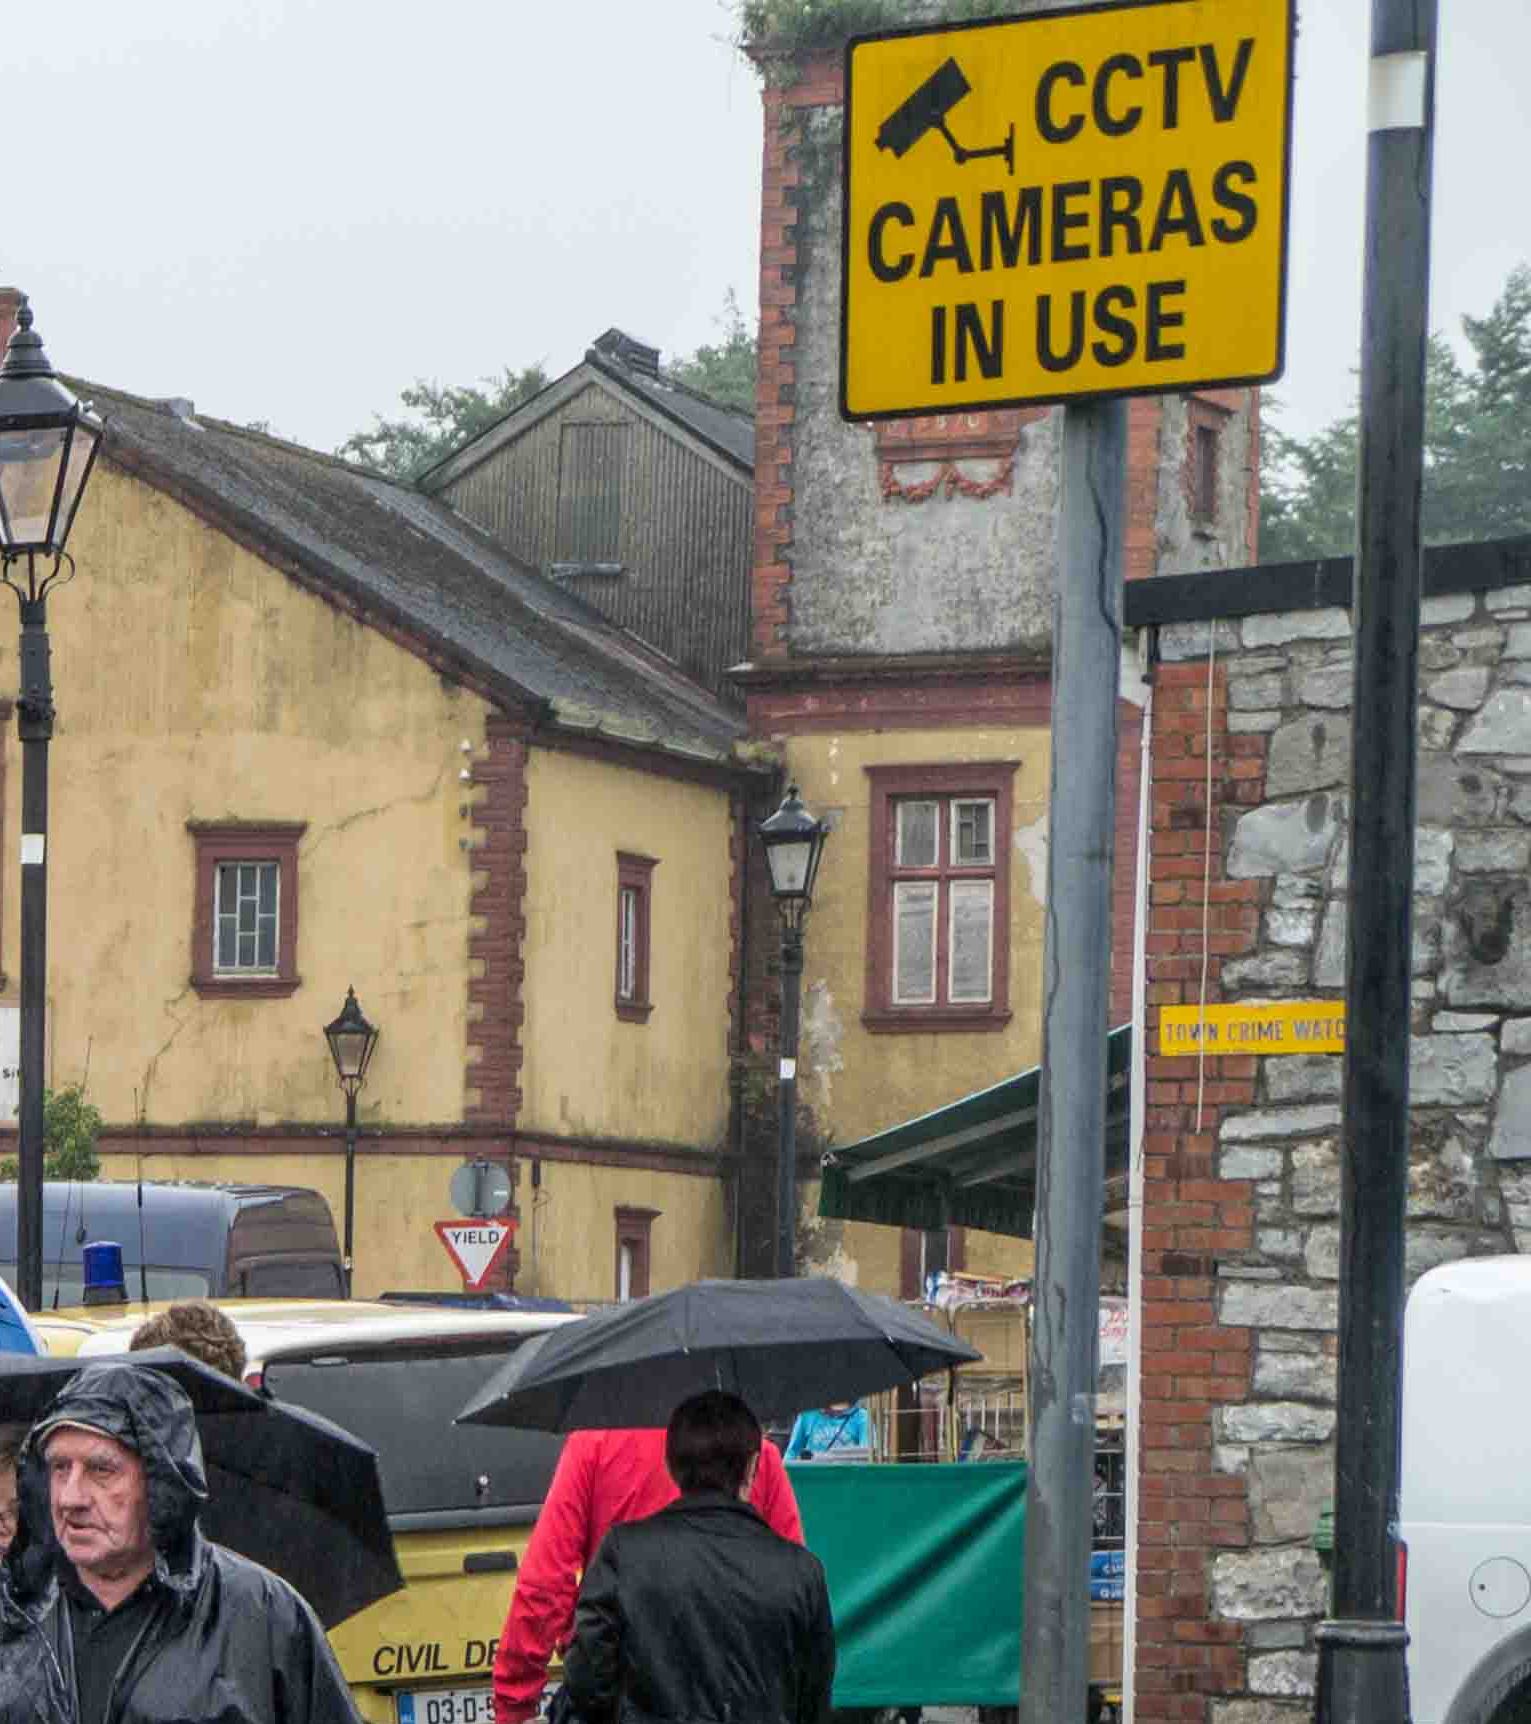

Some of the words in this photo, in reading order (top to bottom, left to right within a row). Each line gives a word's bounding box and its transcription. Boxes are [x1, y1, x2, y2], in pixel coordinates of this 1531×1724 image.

[1035, 38, 1256, 144] CCTV
[866, 160, 1259, 284] CAMERAS
[930, 298, 1004, 386] IN
[1036, 280, 1186, 374] USE
[1166, 1022, 1219, 1041] TOWN
[1227, 1020, 1283, 1041] CRIME
[450, 1230, 500, 1245] YIELD
[373, 1643, 449, 1676] CIVIL
